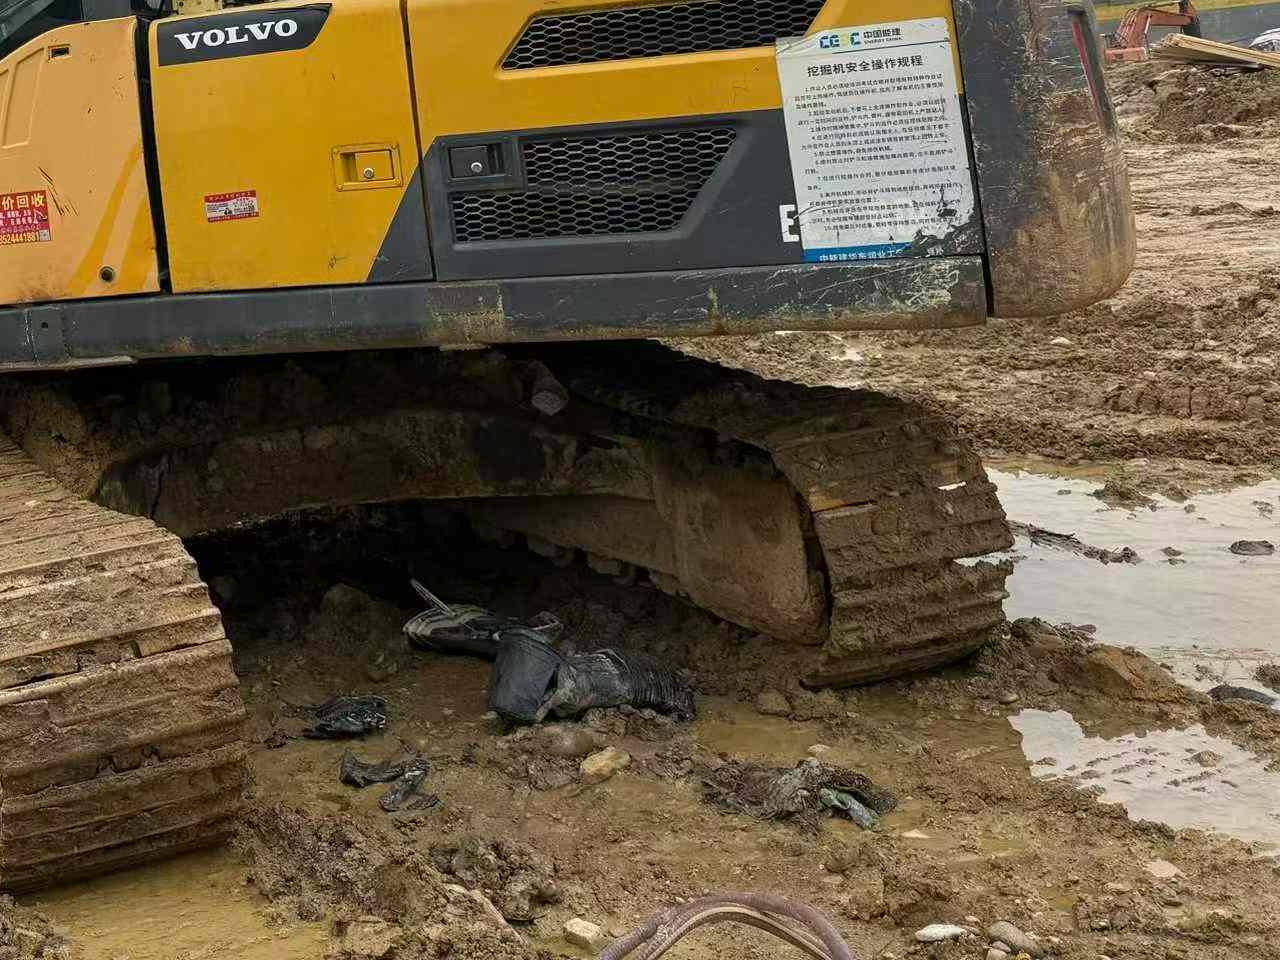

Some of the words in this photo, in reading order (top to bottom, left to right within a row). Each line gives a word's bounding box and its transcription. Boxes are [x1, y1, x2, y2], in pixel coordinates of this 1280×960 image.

[174, 19, 298, 50] VOLVO
[807, 55, 924, 77] 挖掘机安全操作规程
